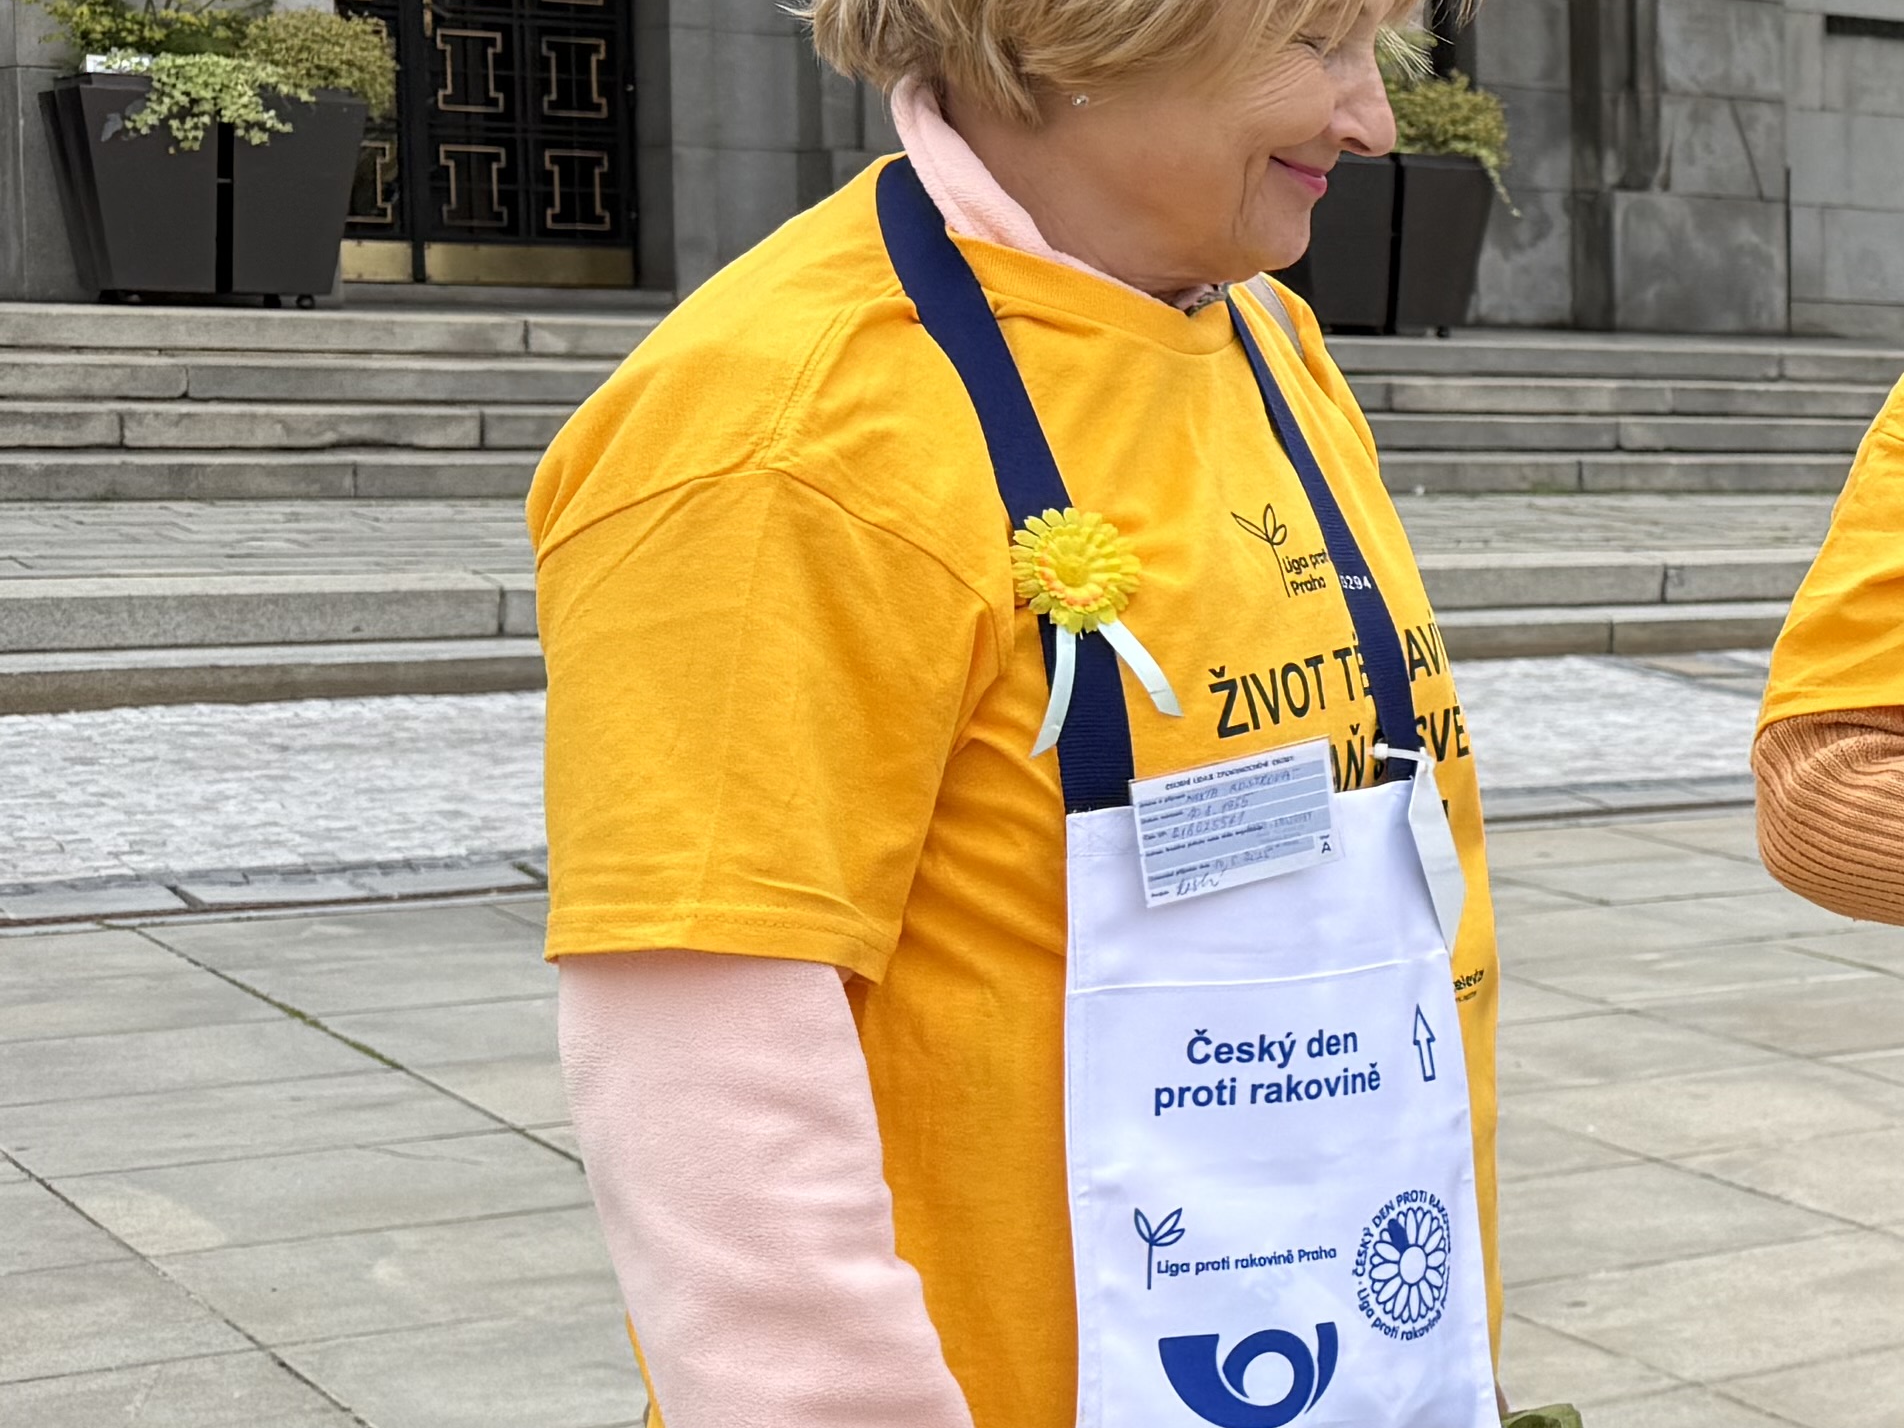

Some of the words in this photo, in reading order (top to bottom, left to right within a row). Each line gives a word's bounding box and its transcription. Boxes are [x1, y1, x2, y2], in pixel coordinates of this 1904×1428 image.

[1311, 548, 1329, 570] prot
[1208, 654, 1325, 739] ŽIVOT
[1404, 609, 1448, 682] AVÍ
[1321, 841, 1332, 854] A
[1186, 1028, 1297, 1069] Český
[1306, 1029, 1358, 1059] den
[1154, 1077, 1237, 1116] proti
[1250, 1061, 1381, 1105] rakovině
[1372, 1200, 1395, 1228] DEN
[1396, 1189, 1427, 1208] PROTI
[1157, 1260, 1190, 1277] Liga
[1195, 1256, 1230, 1276] proti
[1234, 1249, 1294, 1270] rakovině
[1298, 1245, 1337, 1263] Praha
[1371, 1317, 1400, 1339] proti
